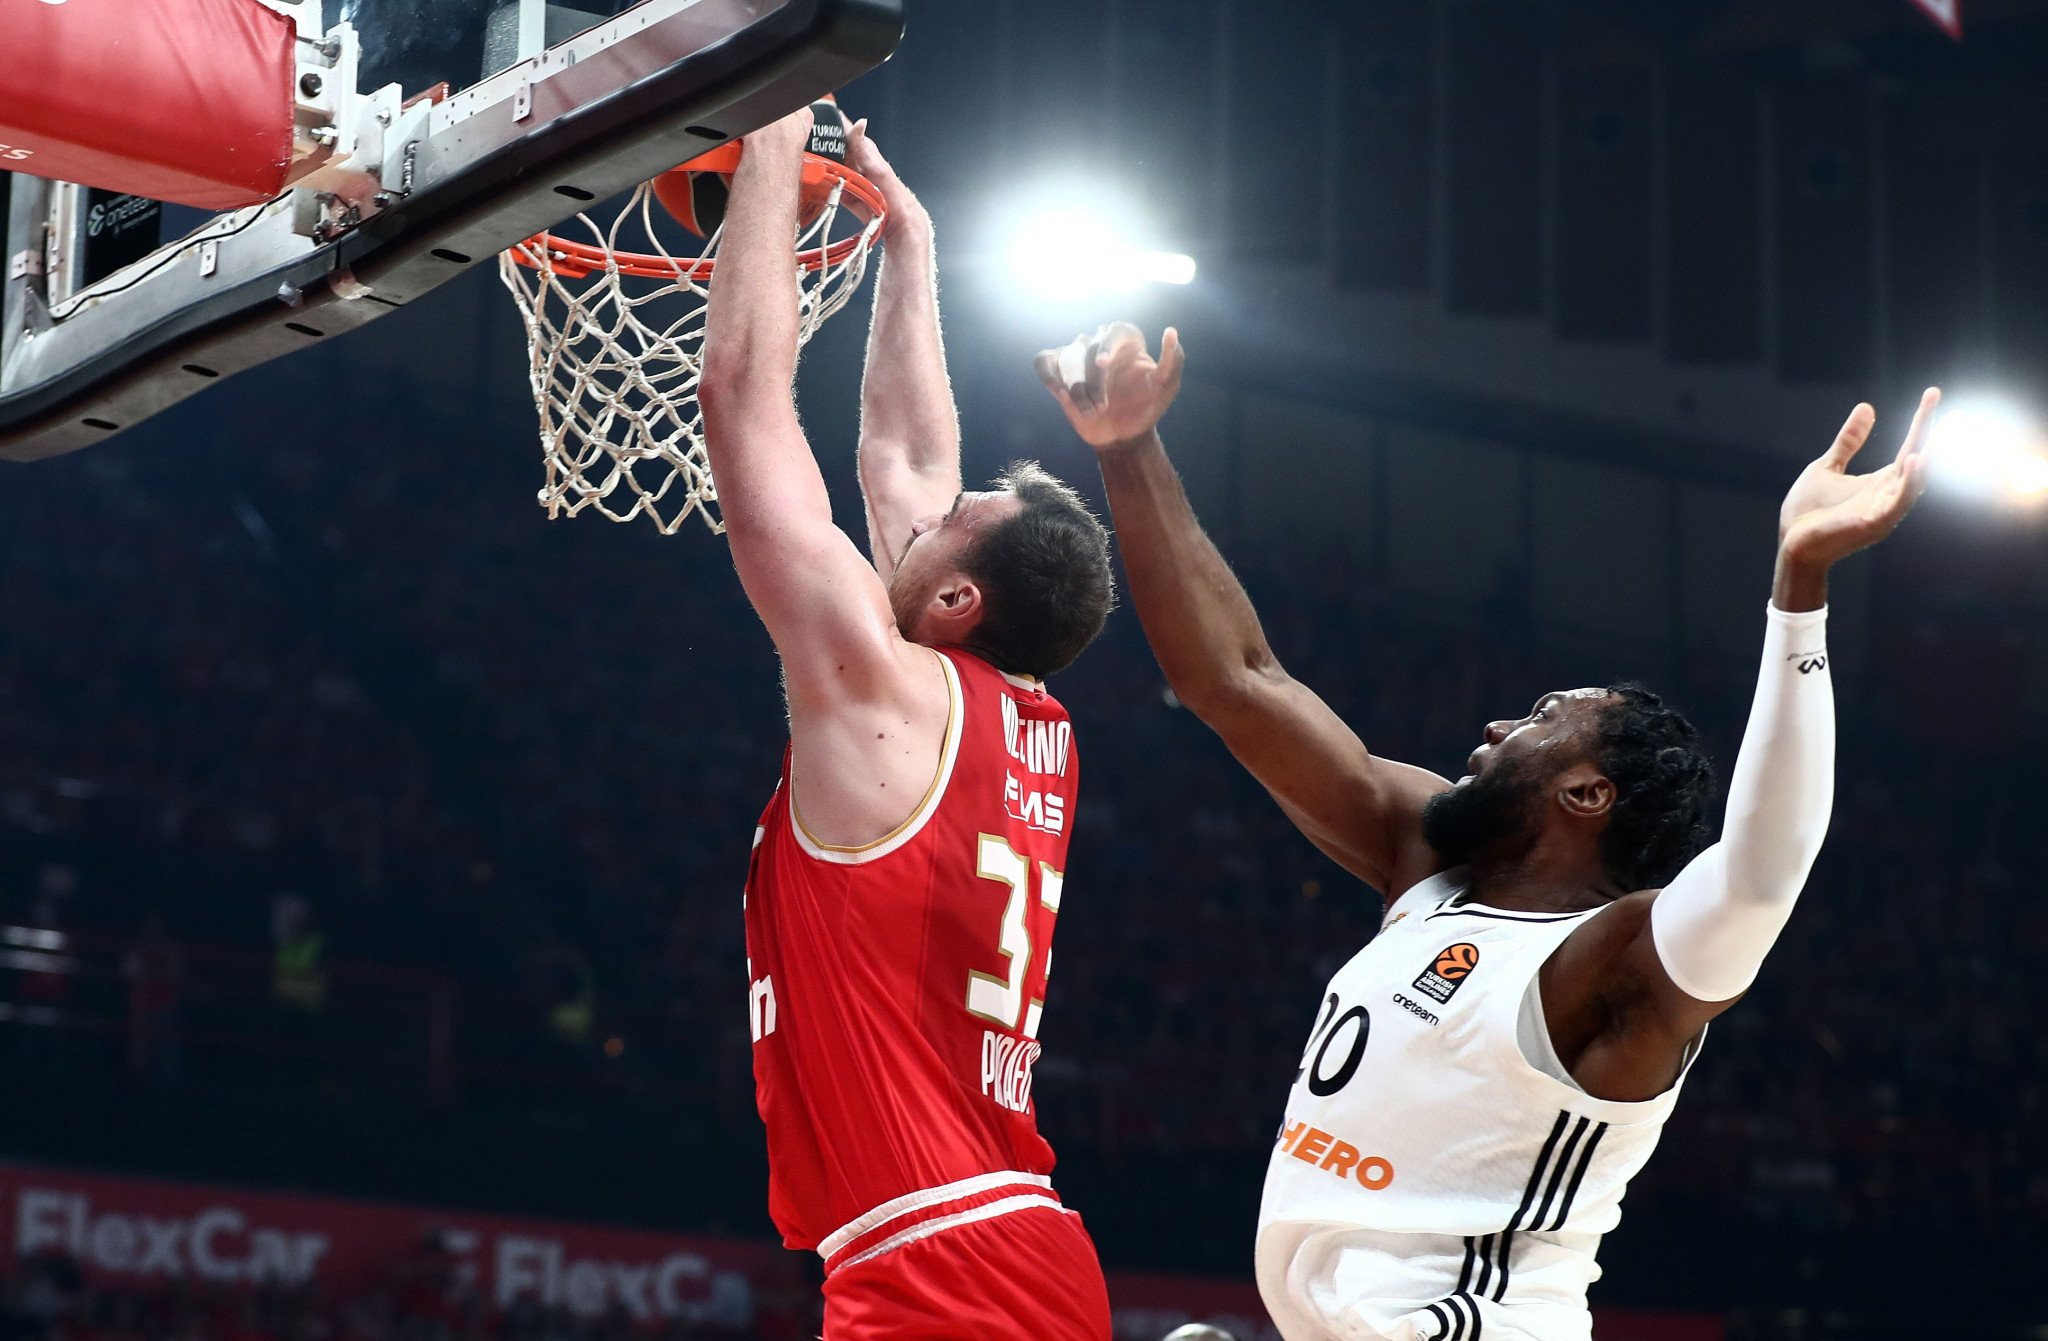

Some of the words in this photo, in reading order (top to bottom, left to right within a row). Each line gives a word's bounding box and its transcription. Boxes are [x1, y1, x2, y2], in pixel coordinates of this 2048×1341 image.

[1420, 976, 1451, 996] AIRLINES
[1425, 970, 1456, 991] TURKISH
[1392, 993, 1440, 1026] oneteam
[1281, 1117, 1394, 1191] HERO
[14, 1190, 328, 1287] FlexCar
